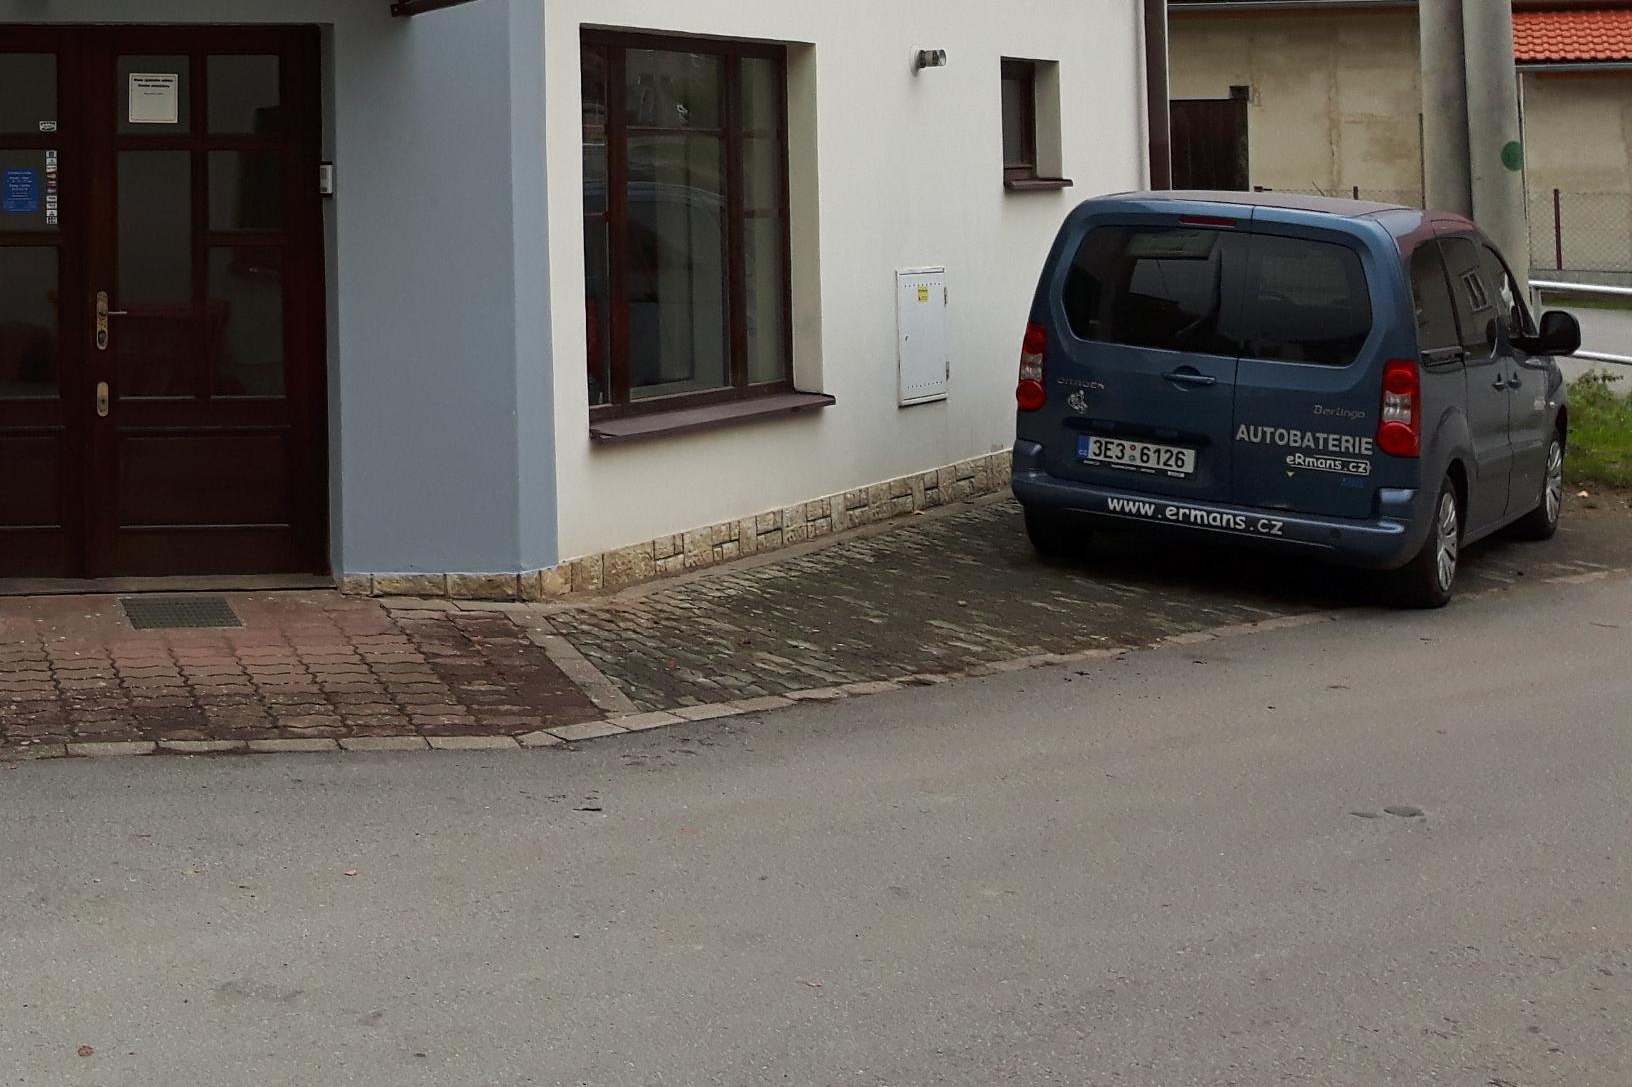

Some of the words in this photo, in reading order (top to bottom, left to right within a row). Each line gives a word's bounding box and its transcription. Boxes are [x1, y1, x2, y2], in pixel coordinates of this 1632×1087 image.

[1313, 404, 1366, 421] Berlingo
[1092, 439, 1126, 460] 3E3
[1139, 446, 1186, 469] 6126
[1235, 424, 1374, 455] AUTOBATERIE
[1285, 453, 1367, 473] eRmans.cz
[1107, 497, 1284, 536] www.ermans.cz
